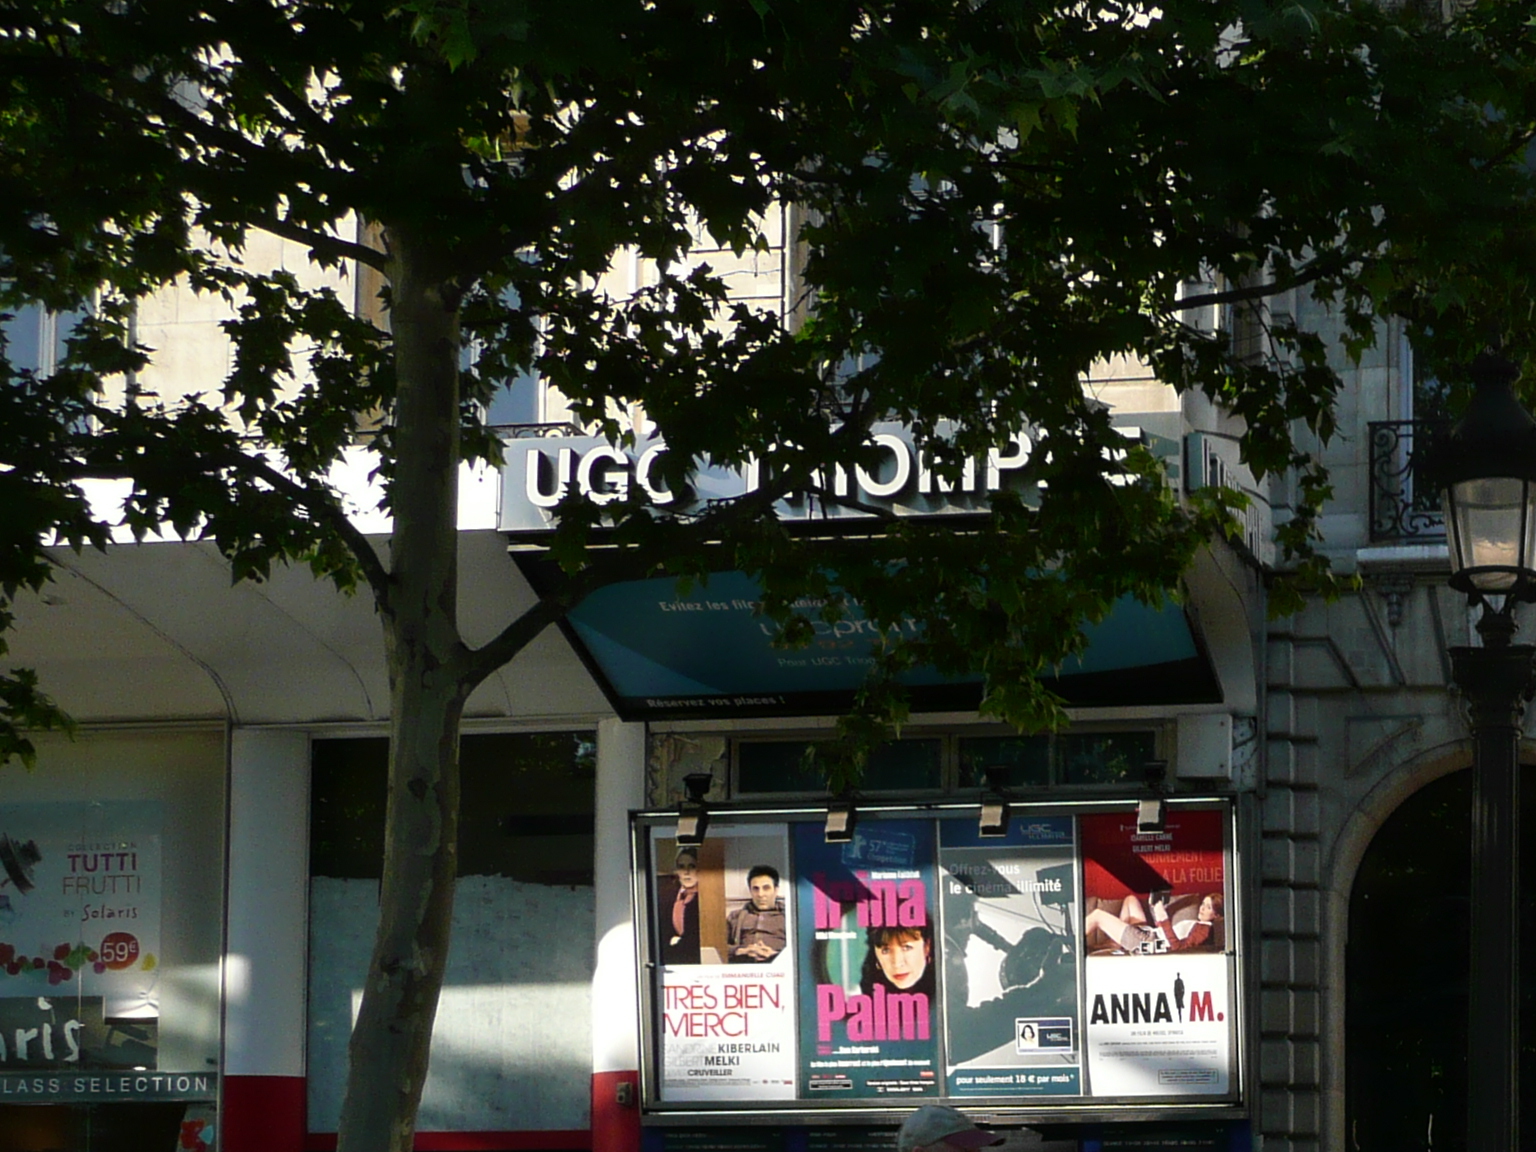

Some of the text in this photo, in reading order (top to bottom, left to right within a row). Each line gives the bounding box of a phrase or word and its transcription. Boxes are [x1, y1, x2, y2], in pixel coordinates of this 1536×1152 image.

[525, 443, 671, 508] UGC
[658, 601, 702, 613] Evitez
[706, 601, 728, 611] les
[646, 698, 704, 709] Réservez
[708, 698, 729, 707] vos
[733, 696, 775, 707] places
[67, 853, 136, 872] TUTTI
[950, 862, 1021, 876] Offrez-vous
[1172, 868, 1187, 883] LA
[63, 875, 140, 895] FRUTTI
[950, 878, 1062, 894] le cinéma illimité
[814, 868, 927, 929] Irina
[723, 984, 785, 1013] BIEN,
[1090, 990, 1225, 1025] ANNA M.
[816, 982, 931, 1042] Palm
[662, 1012, 748, 1037] MERCI
[704, 1056, 741, 1066] MELKI
[74, 1076, 207, 1093] SELECTION
[956, 1075, 974, 1086] pour
[975, 1074, 1014, 1085] seulement
[1037, 1075, 1050, 1085] par
